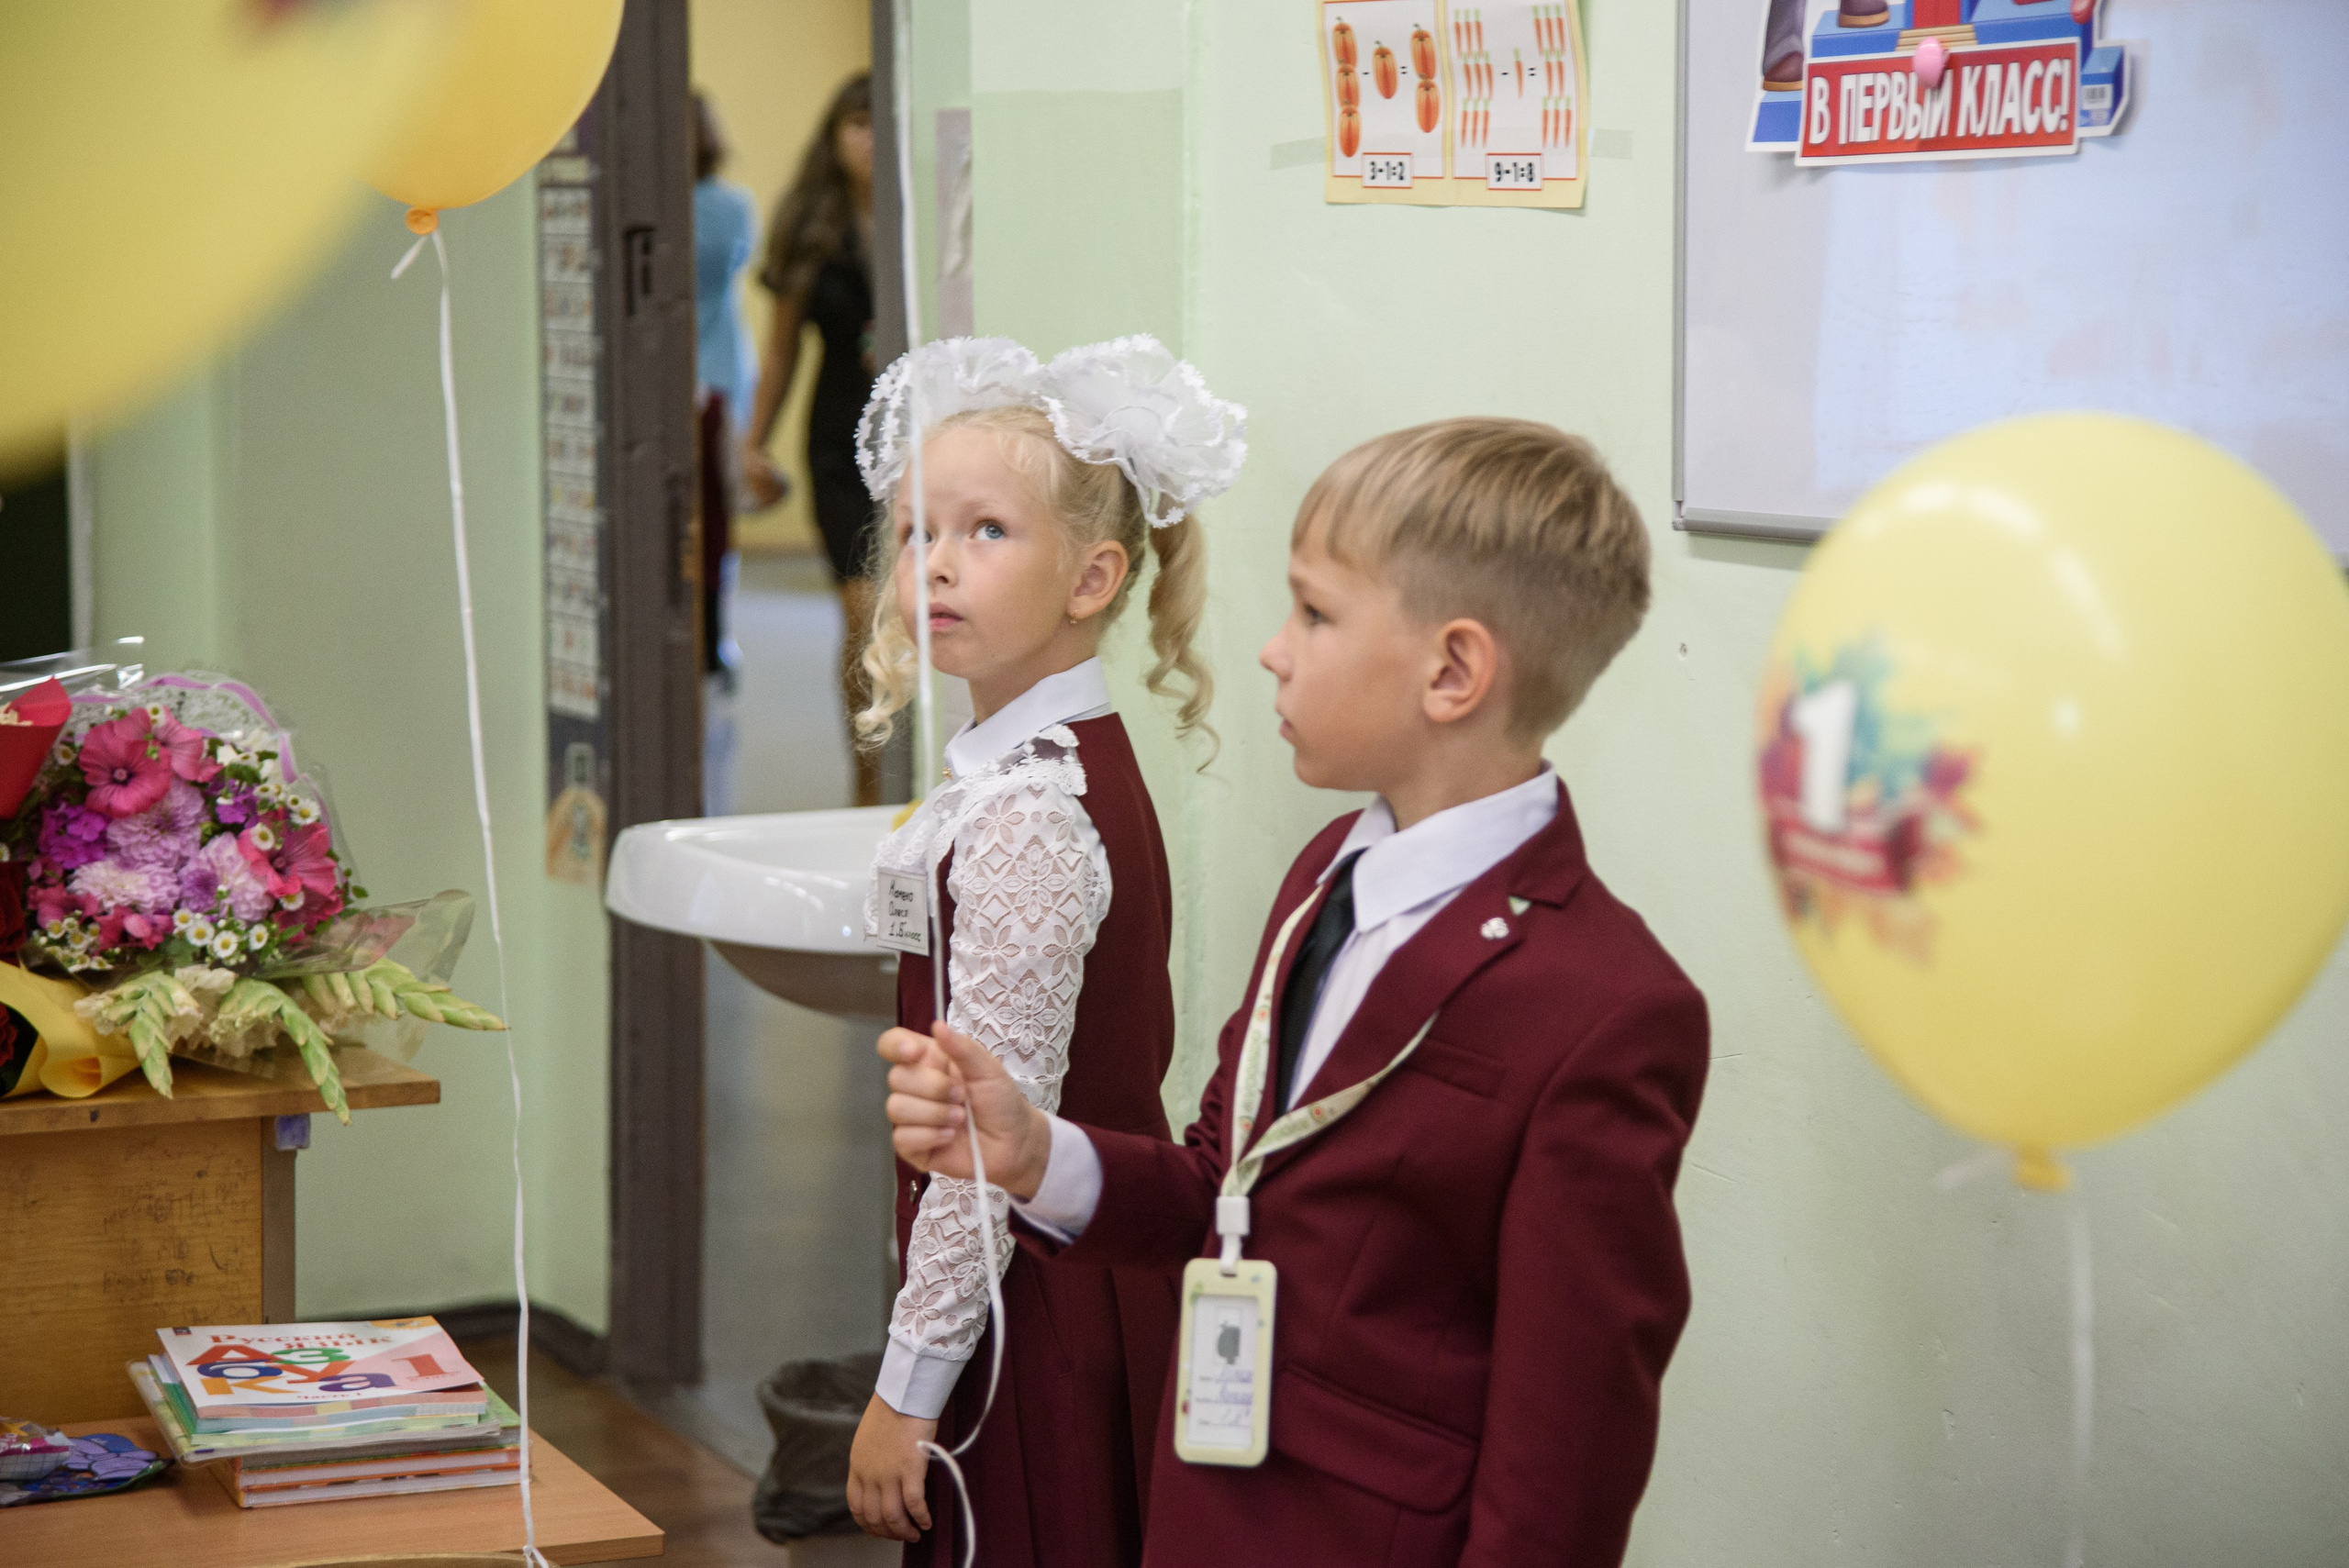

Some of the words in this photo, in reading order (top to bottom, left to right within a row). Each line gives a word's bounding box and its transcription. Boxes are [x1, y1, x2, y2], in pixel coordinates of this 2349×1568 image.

[1809, 76, 1831, 145] В
[1955, 58, 2071, 139] КЛАСС!
[1790, 679, 1858, 831] 1
[210, 1333, 356, 1344] Русский
[392, 1353, 461, 1378] 1
